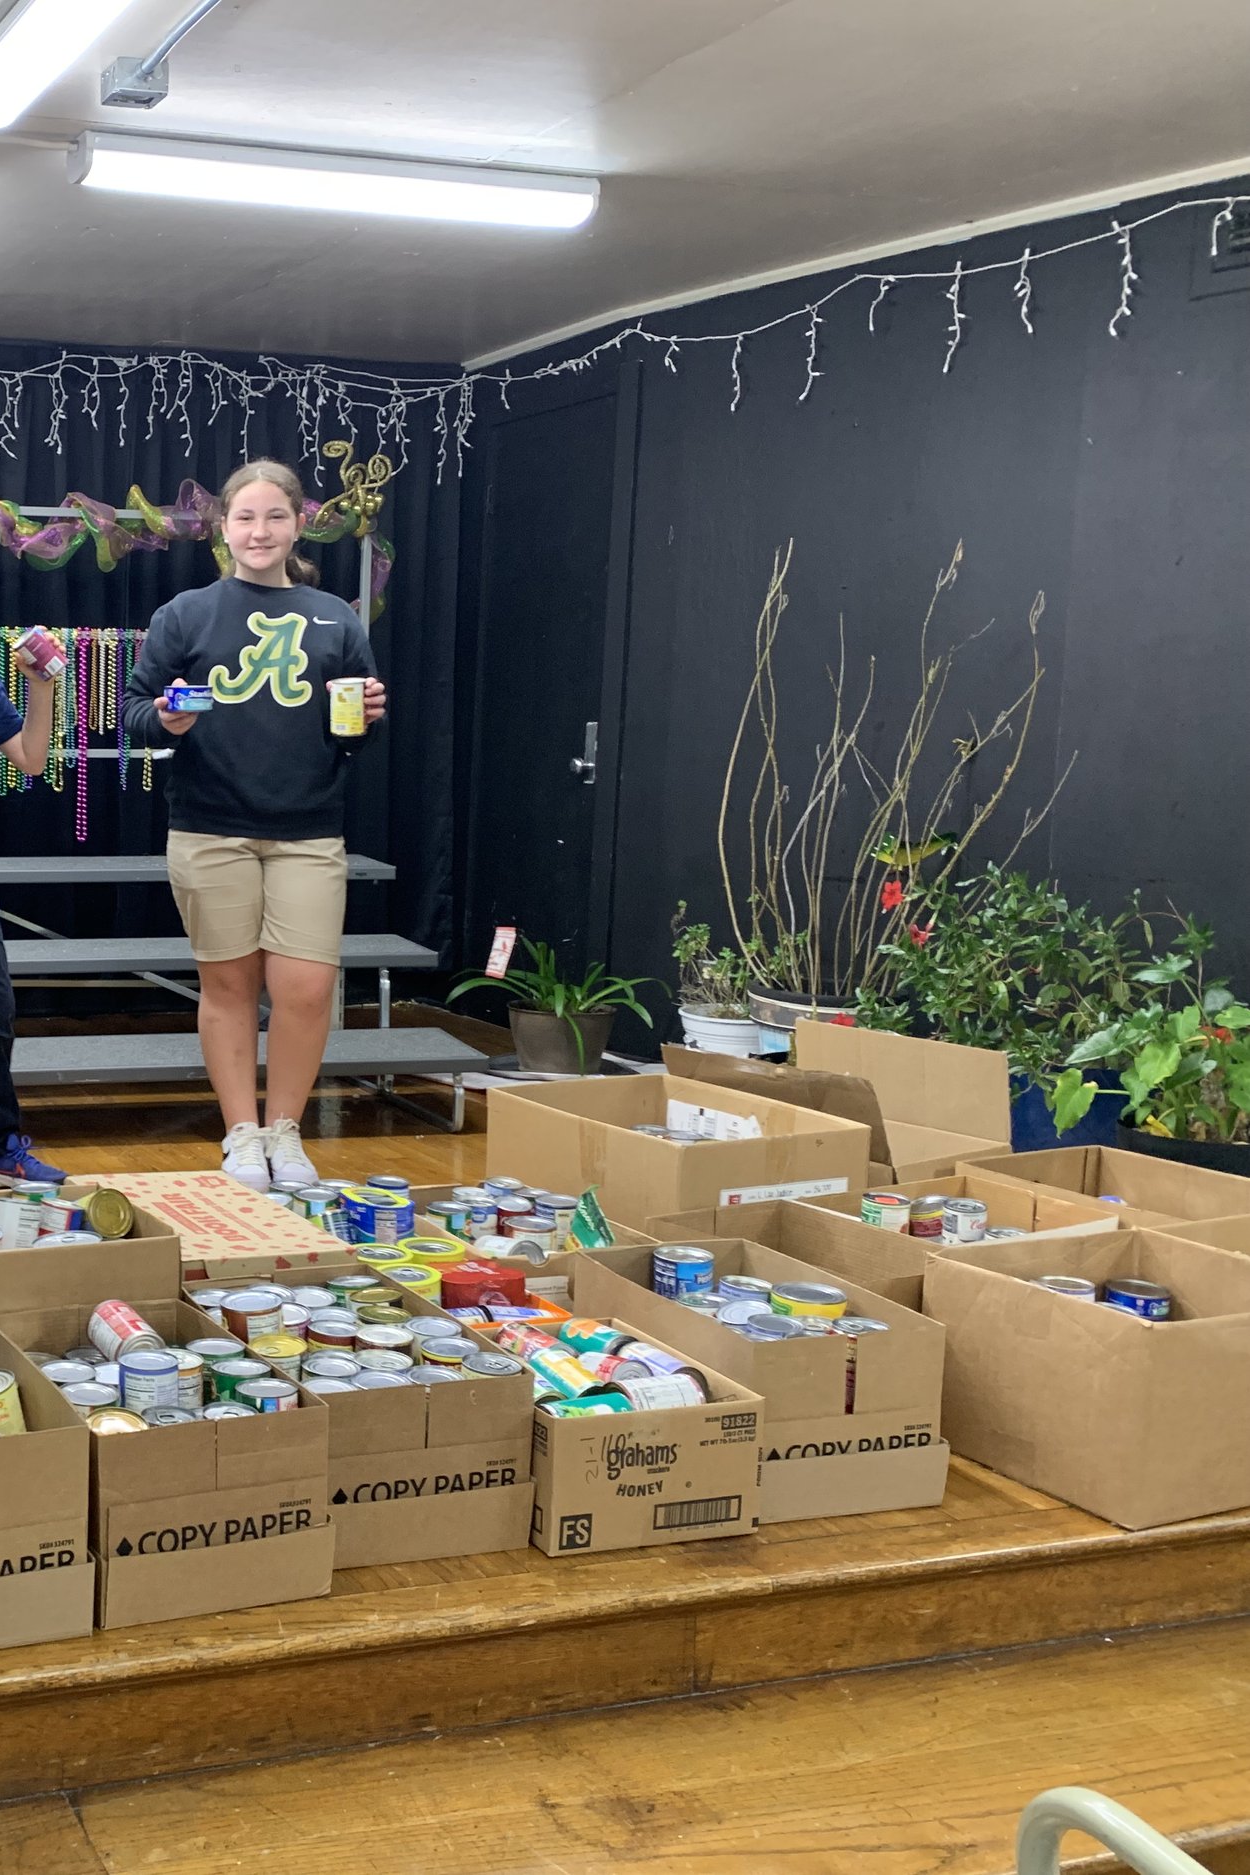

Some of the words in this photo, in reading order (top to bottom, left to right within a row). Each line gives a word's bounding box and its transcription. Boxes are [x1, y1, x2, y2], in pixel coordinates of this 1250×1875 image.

[208, 611, 313, 707] A
[722, 1414, 756, 1429] 91822
[607, 1442, 678, 1480] grahams
[353, 1477, 427, 1504] COPY
[434, 1468, 516, 1495] PAPER
[616, 1480, 664, 1497] HONEY
[137, 1521, 218, 1554] COPY
[225, 1509, 312, 1544] PAPER
[562, 1519, 590, 1547] FS
